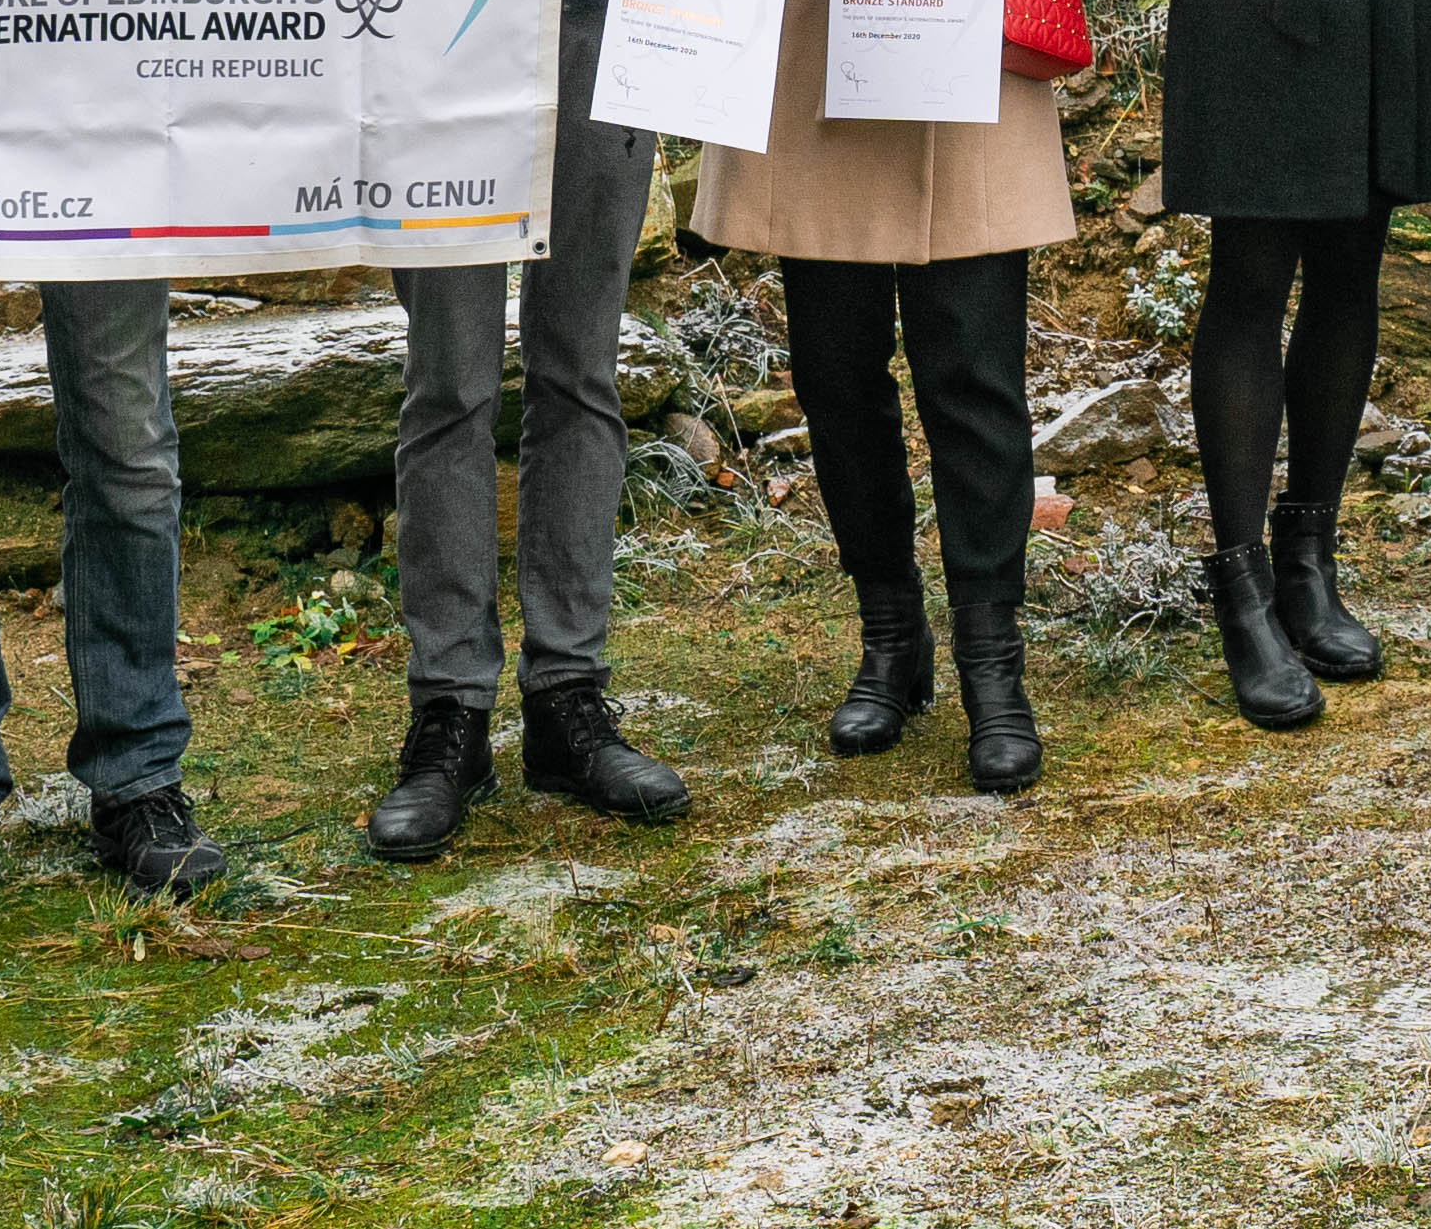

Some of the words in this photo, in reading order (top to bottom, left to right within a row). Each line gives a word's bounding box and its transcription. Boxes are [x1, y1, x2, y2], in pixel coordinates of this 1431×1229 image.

[202, 11, 326, 40] AWARD
[136, 59, 204, 78] CZECH
[213, 58, 324, 78] REPUBLIC
[295, 176, 344, 214] MÁ
[355, 180, 392, 209] TO
[405, 179, 497, 209] CENU!
